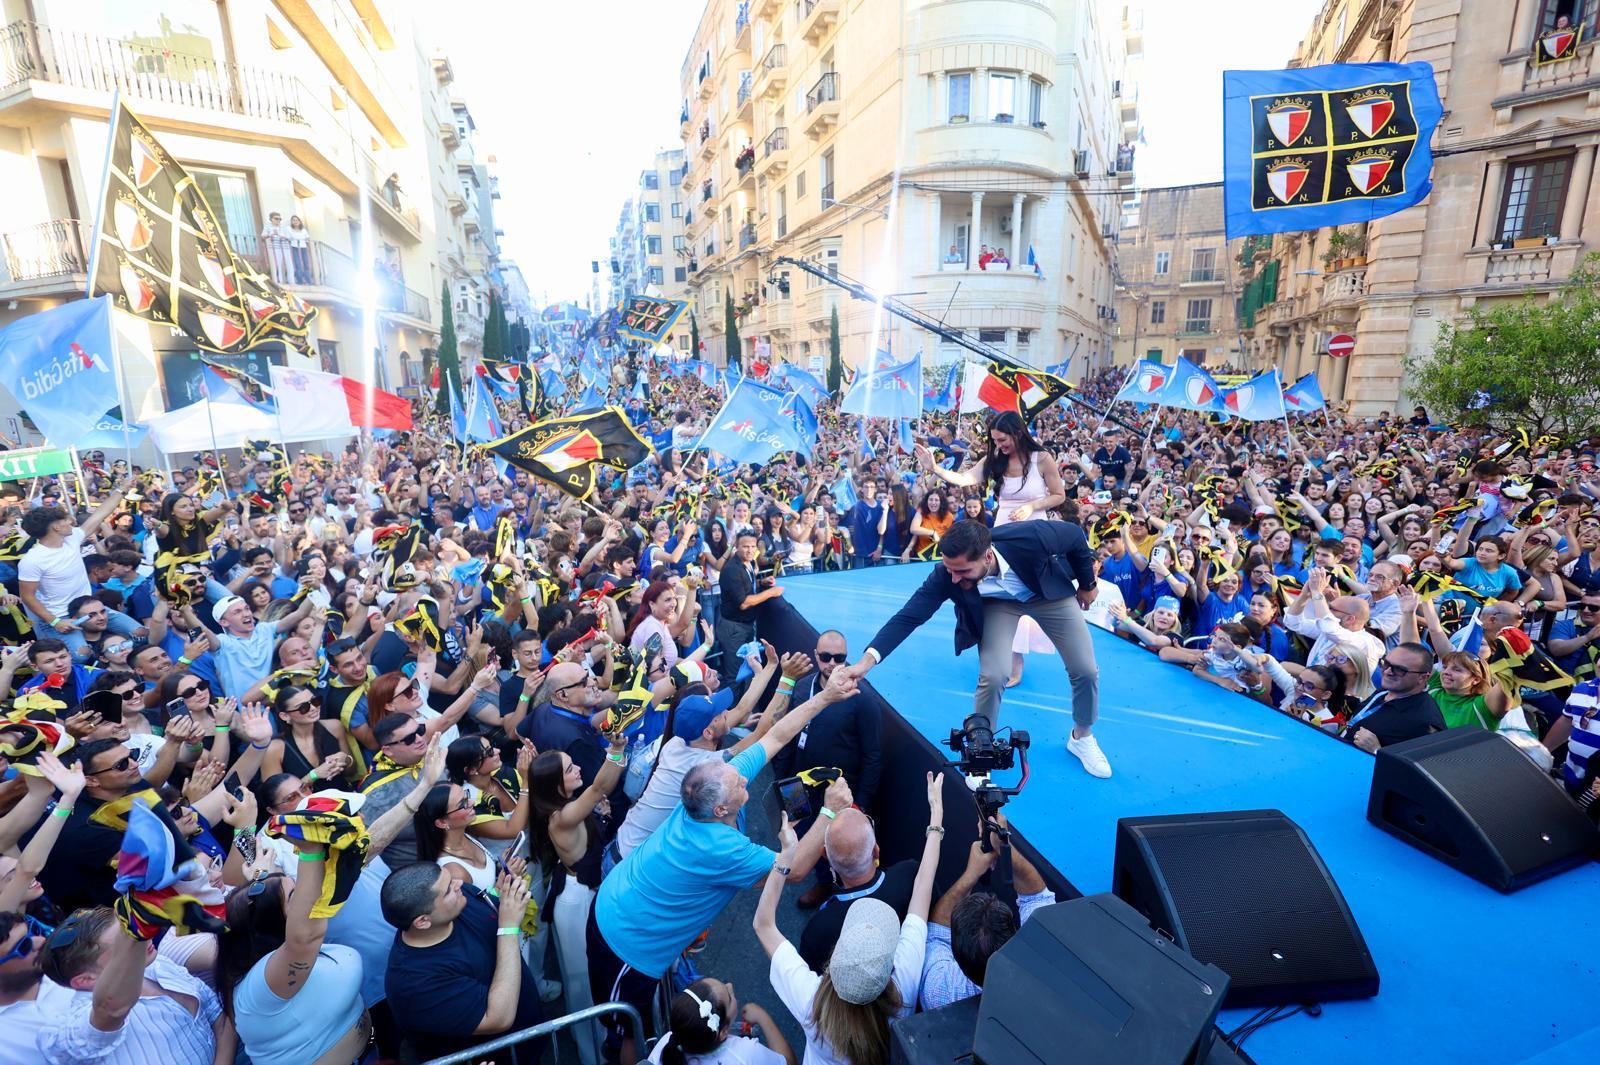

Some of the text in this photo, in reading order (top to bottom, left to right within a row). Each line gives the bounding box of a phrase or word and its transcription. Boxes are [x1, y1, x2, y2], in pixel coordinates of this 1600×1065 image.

[1351, 125, 1398, 141] P. N.
[1268, 135, 1314, 149] P. N.
[1345, 184, 1391, 196] P. N.
[1267, 193, 1309, 205] P. N.
[152, 310, 166, 320] N.
[568, 472, 585, 488] P.
